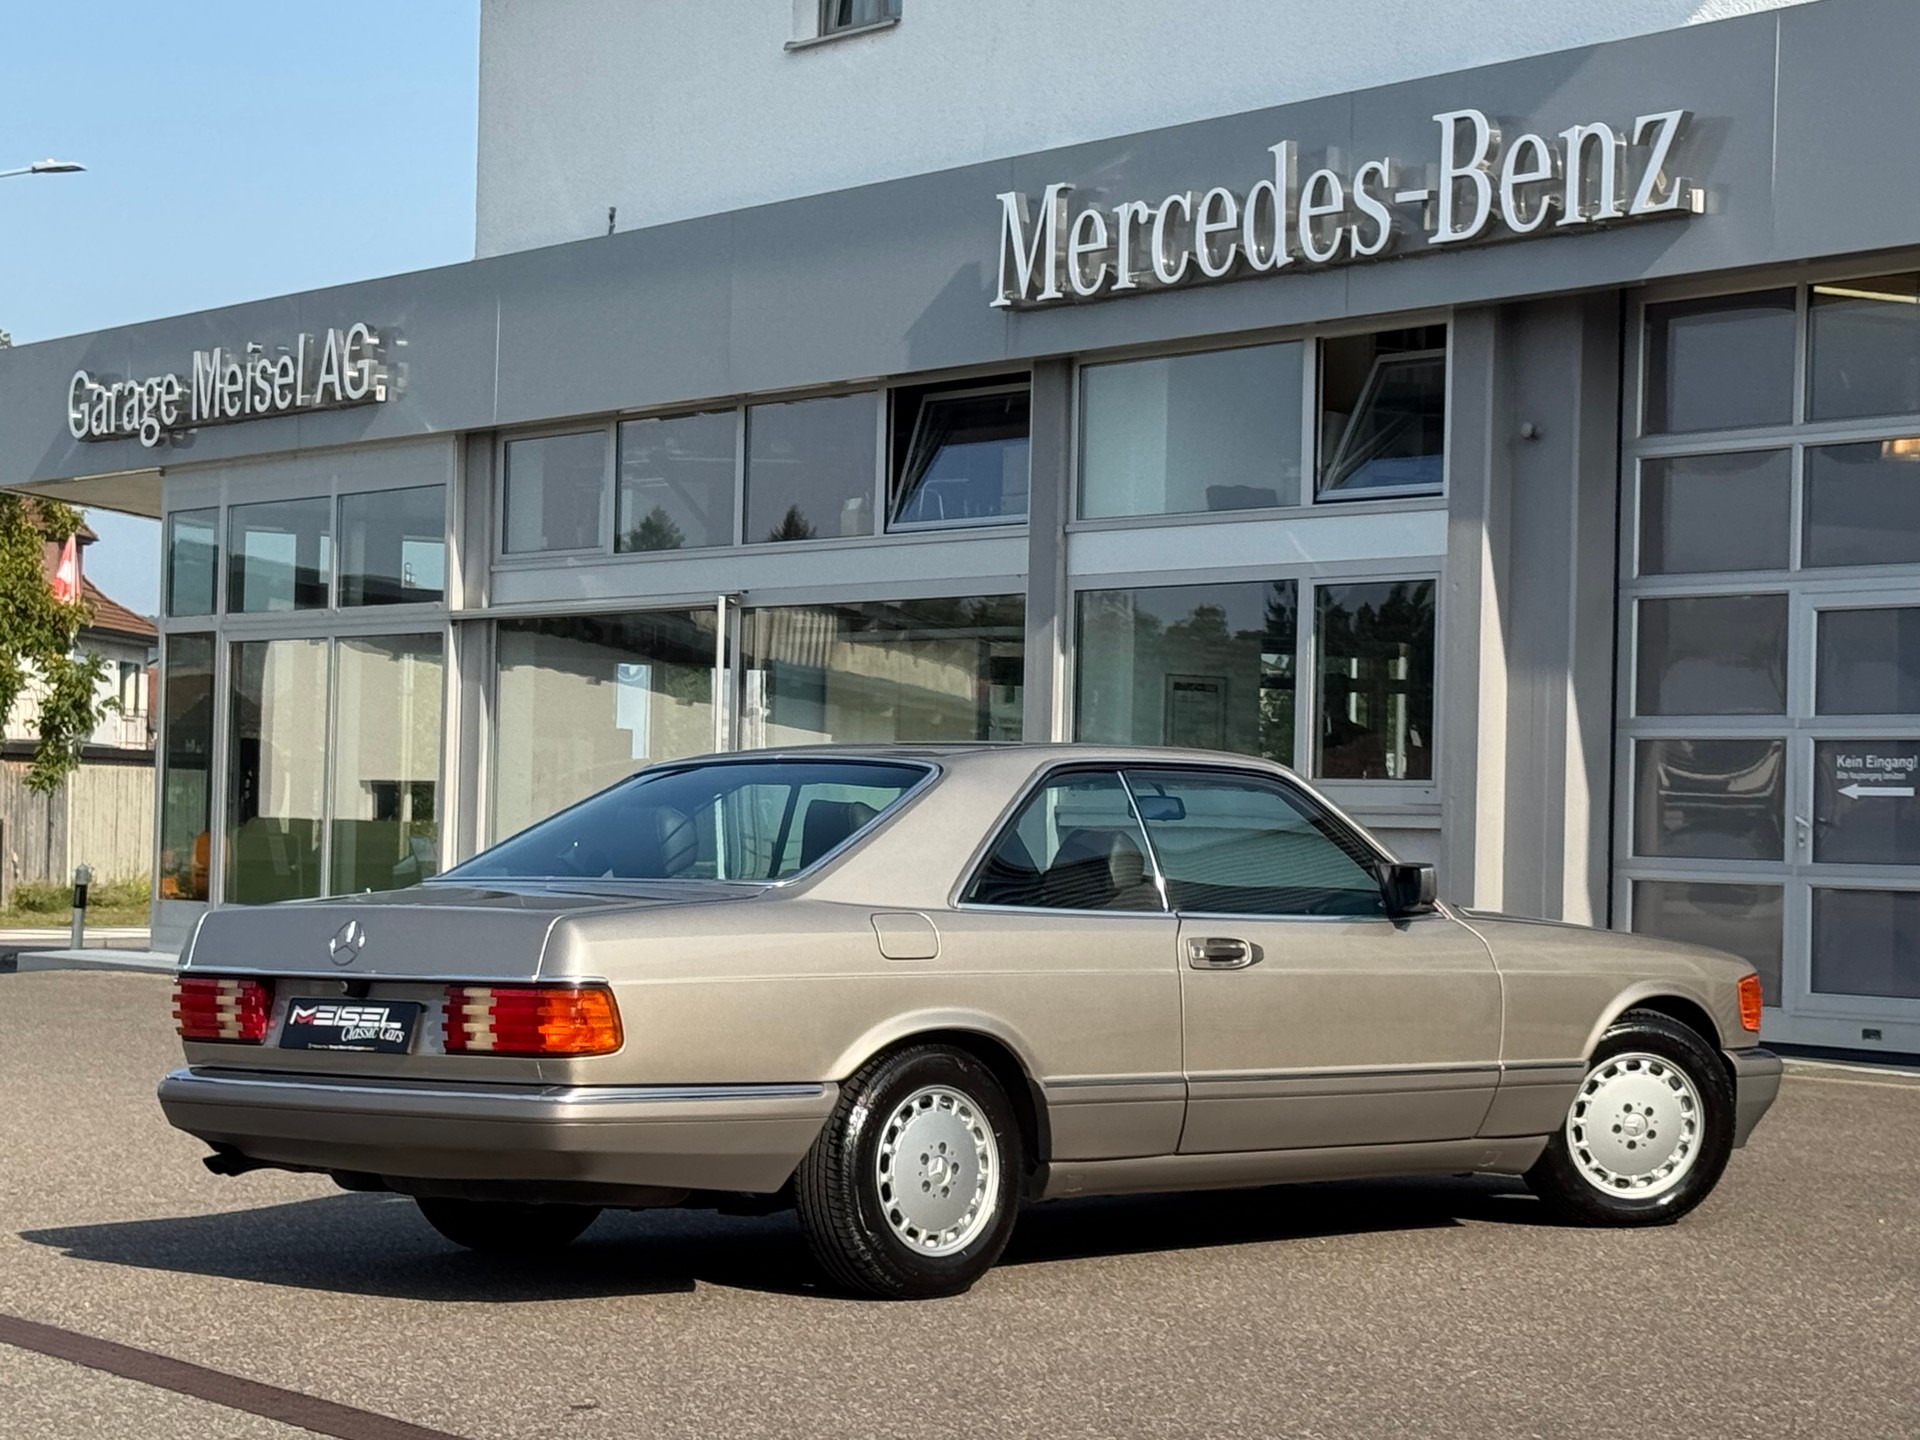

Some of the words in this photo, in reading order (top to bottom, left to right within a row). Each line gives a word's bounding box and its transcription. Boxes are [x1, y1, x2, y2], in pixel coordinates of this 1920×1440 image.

[990, 108, 1689, 307] Mercedes-Benz
[68, 370, 180, 447] Garage
[191, 333, 305, 420] Meisel
[315, 322, 377, 403] AG
[1836, 754, 1863, 768] Kein
[1866, 754, 1918, 771] Eingang!
[289, 1005, 402, 1029] MEISEL
[341, 1025, 379, 1042] Classic
[379, 1025, 405, 1043] Cars
